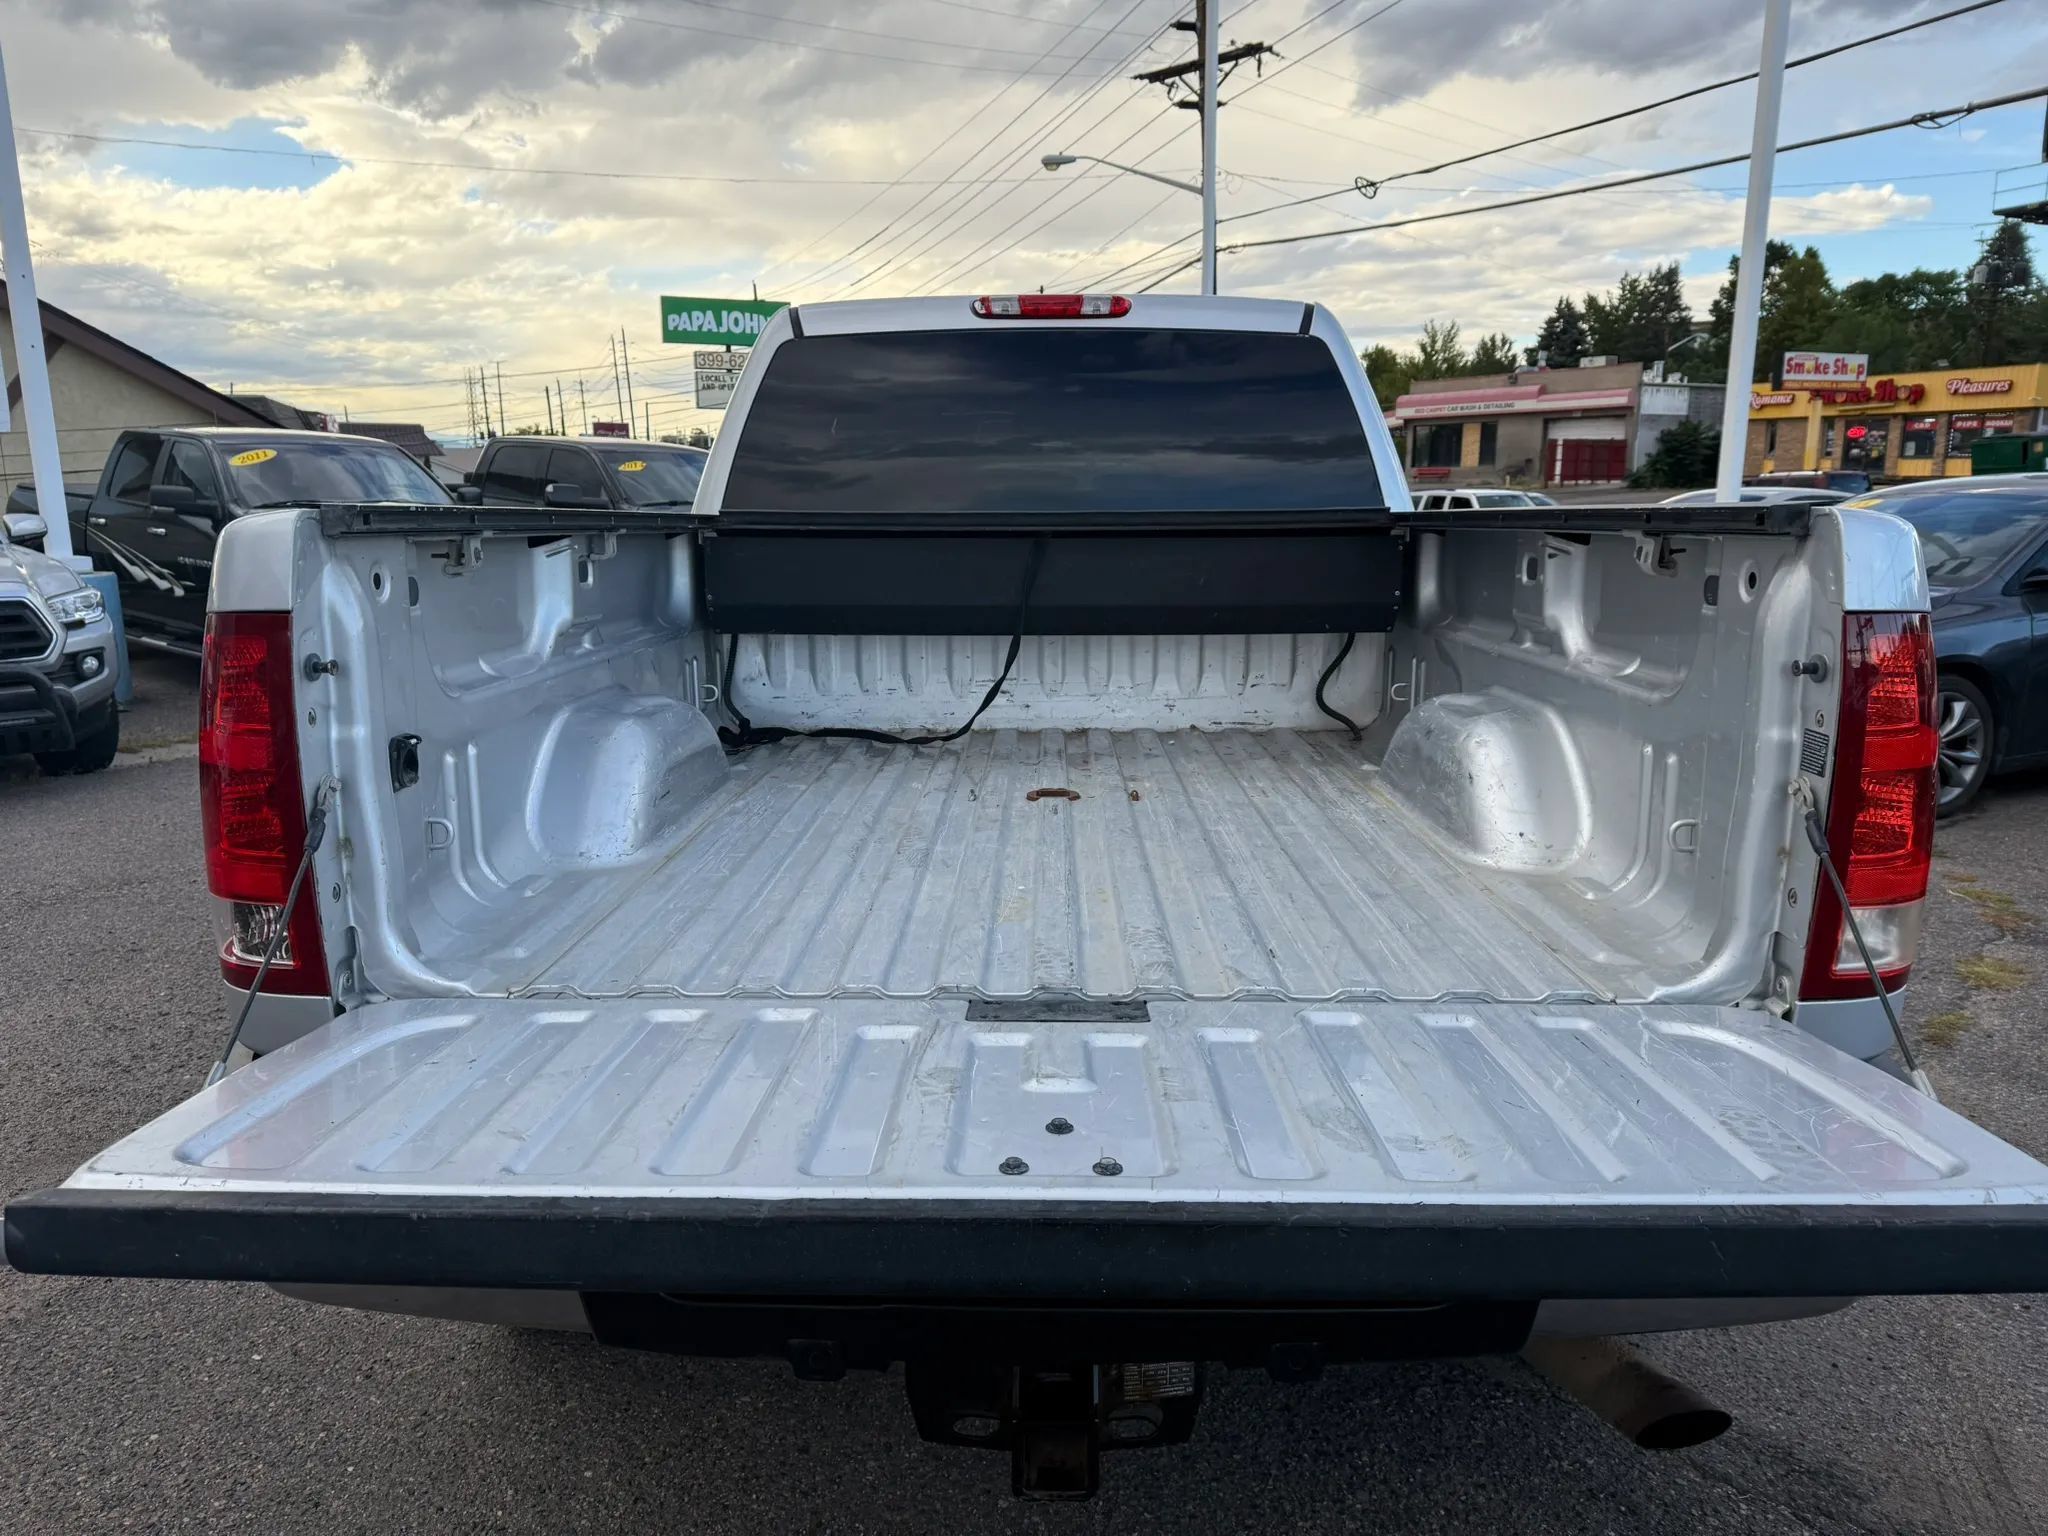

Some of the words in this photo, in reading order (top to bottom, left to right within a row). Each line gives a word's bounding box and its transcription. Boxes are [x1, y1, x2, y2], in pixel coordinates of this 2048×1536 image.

[667, 310, 718, 333] PAPA
[698, 352, 747, 369] 399-62
[1785, 356, 1830, 376] Smoke
[1833, 357, 1866, 380] Shop
[1947, 378, 2012, 395] Pleasures
[1459, 403, 1477, 412] WASH
[1483, 402, 1515, 410] DETAILING
[1751, 393, 1794, 410] Romance
[238, 450, 268, 464] 2011
